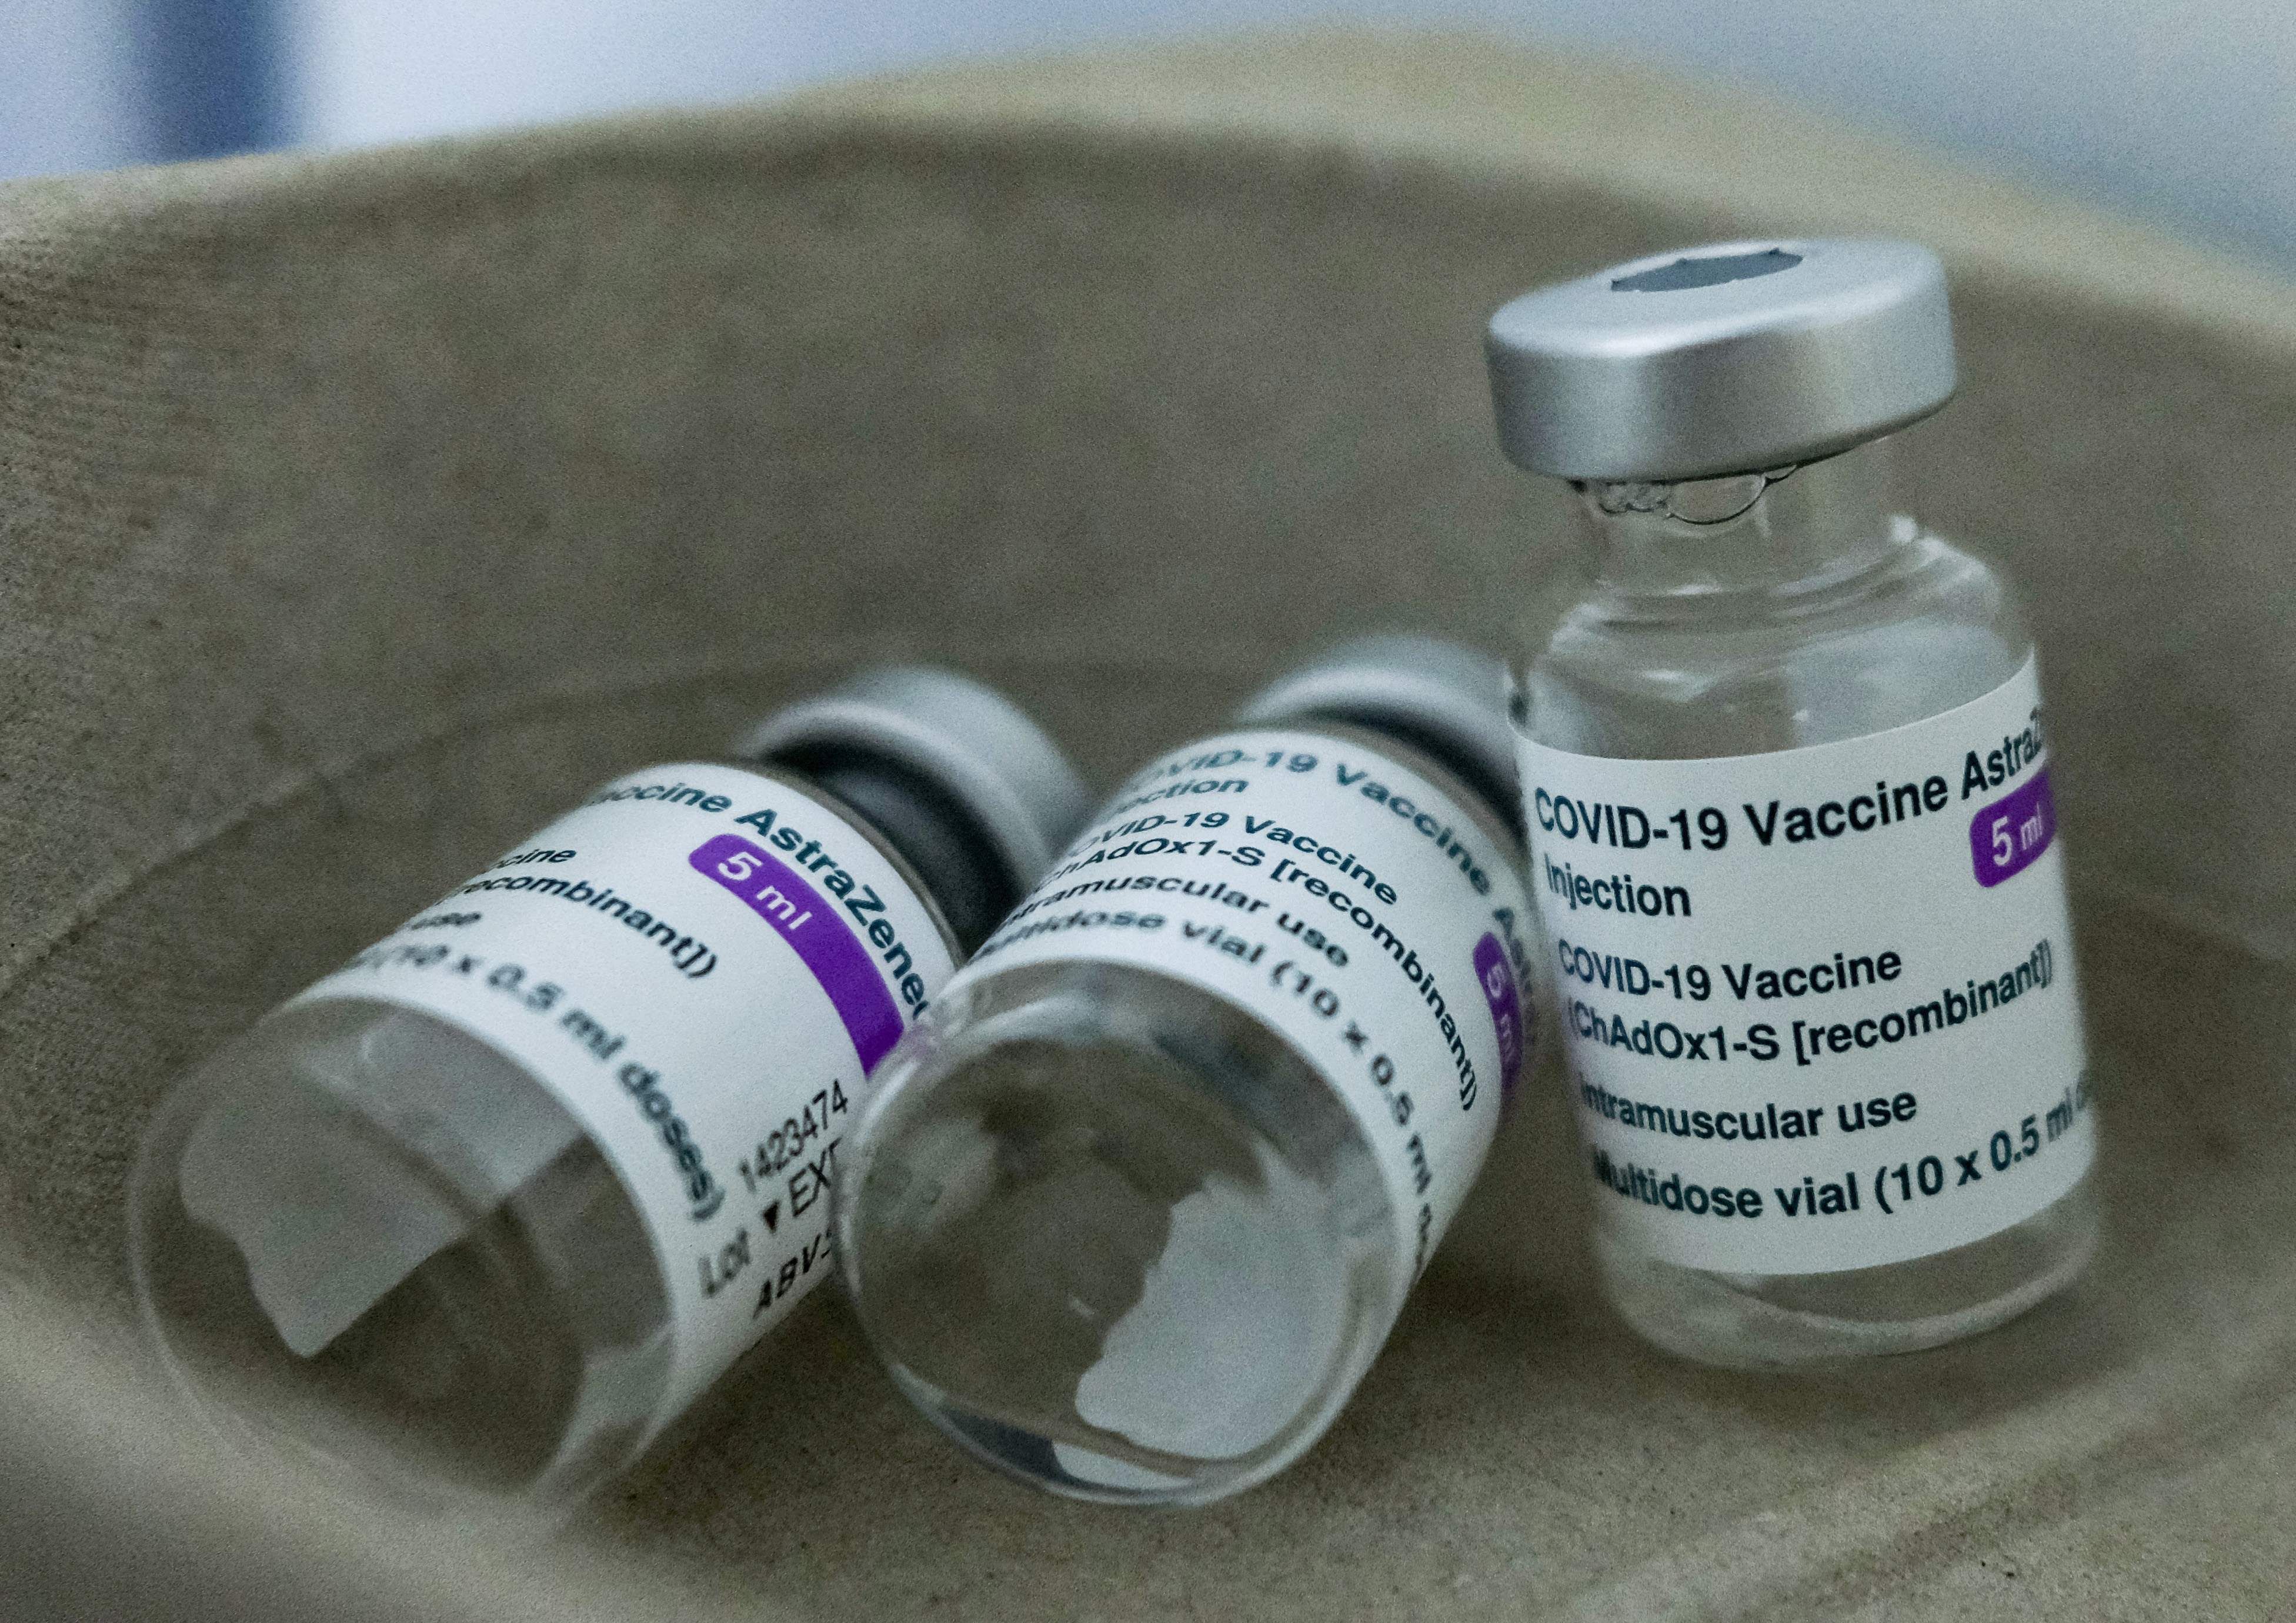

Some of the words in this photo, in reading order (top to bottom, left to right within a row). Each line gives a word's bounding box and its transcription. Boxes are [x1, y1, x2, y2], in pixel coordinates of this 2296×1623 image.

[1335, 762, 1490, 896] Vaccine
[1534, 786, 1729, 851] COVID-19
[1742, 775, 1948, 847] Vaccine
[1991, 815, 2012, 867] 5
[2019, 801, 2043, 851] ml
[717, 851, 763, 881] 5
[756, 884, 813, 931] ml
[1070, 812, 1229, 857] OVID-19
[1245, 815, 1397, 906] Vaccine
[1543, 851, 1691, 917] Injection
[1277, 911, 1349, 967] use
[1559, 939, 1711, 1001] COVID-19
[1721, 950, 1902, 1000] Vaccine
[1182, 920, 1266, 964] vial
[1269, 960, 1340, 1017] (10
[1343, 1019, 1368, 1053] x
[1269, 859, 1477, 1111] [recombinant])
[1792, 938, 2054, 1067] [recombinant])
[486, 962, 565, 1013] 0.5
[619, 1061, 726, 1221] doses)
[1837, 1091, 1917, 1133] use
[739, 1078, 849, 1194] 1423474
[1774, 1170, 1860, 1217] vial
[1874, 1154, 1943, 1215] (10
[1954, 1149, 1982, 1186] x
[1990, 1113, 2040, 1171] 0.5
[2045, 1087, 2073, 1143] ml
[698, 1227, 750, 1298] Lot
